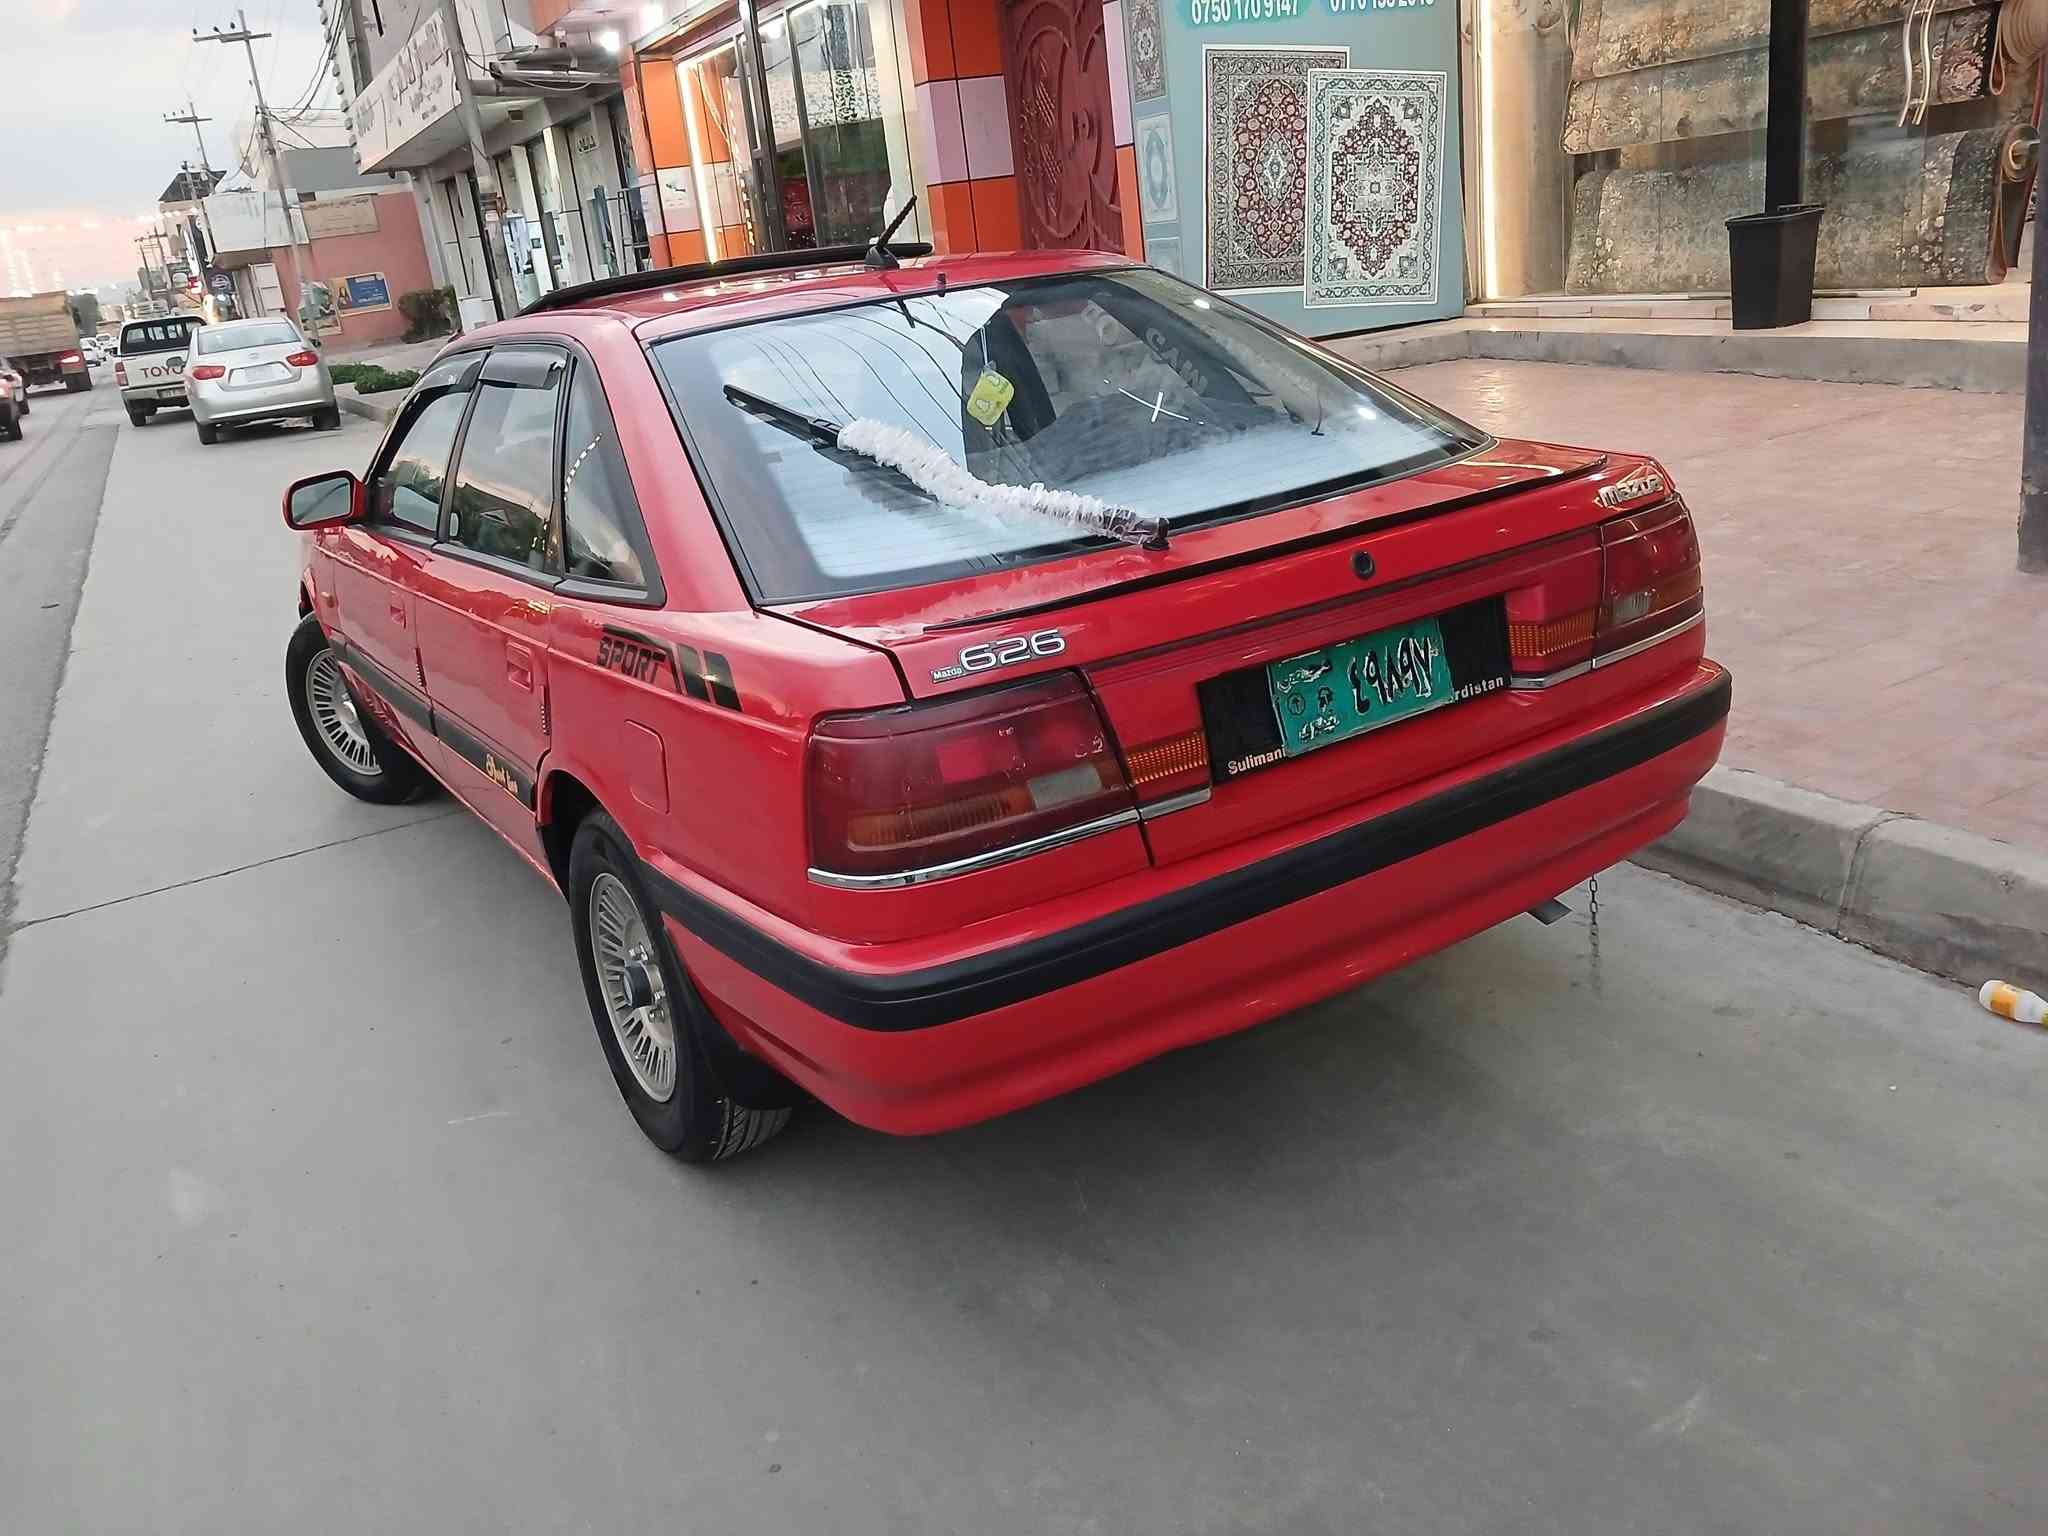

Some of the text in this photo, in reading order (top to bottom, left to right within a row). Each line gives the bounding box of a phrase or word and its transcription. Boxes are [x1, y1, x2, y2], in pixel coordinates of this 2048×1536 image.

[597, 635, 667, 684] SPORT
[933, 629, 1066, 680] Mazda 626
